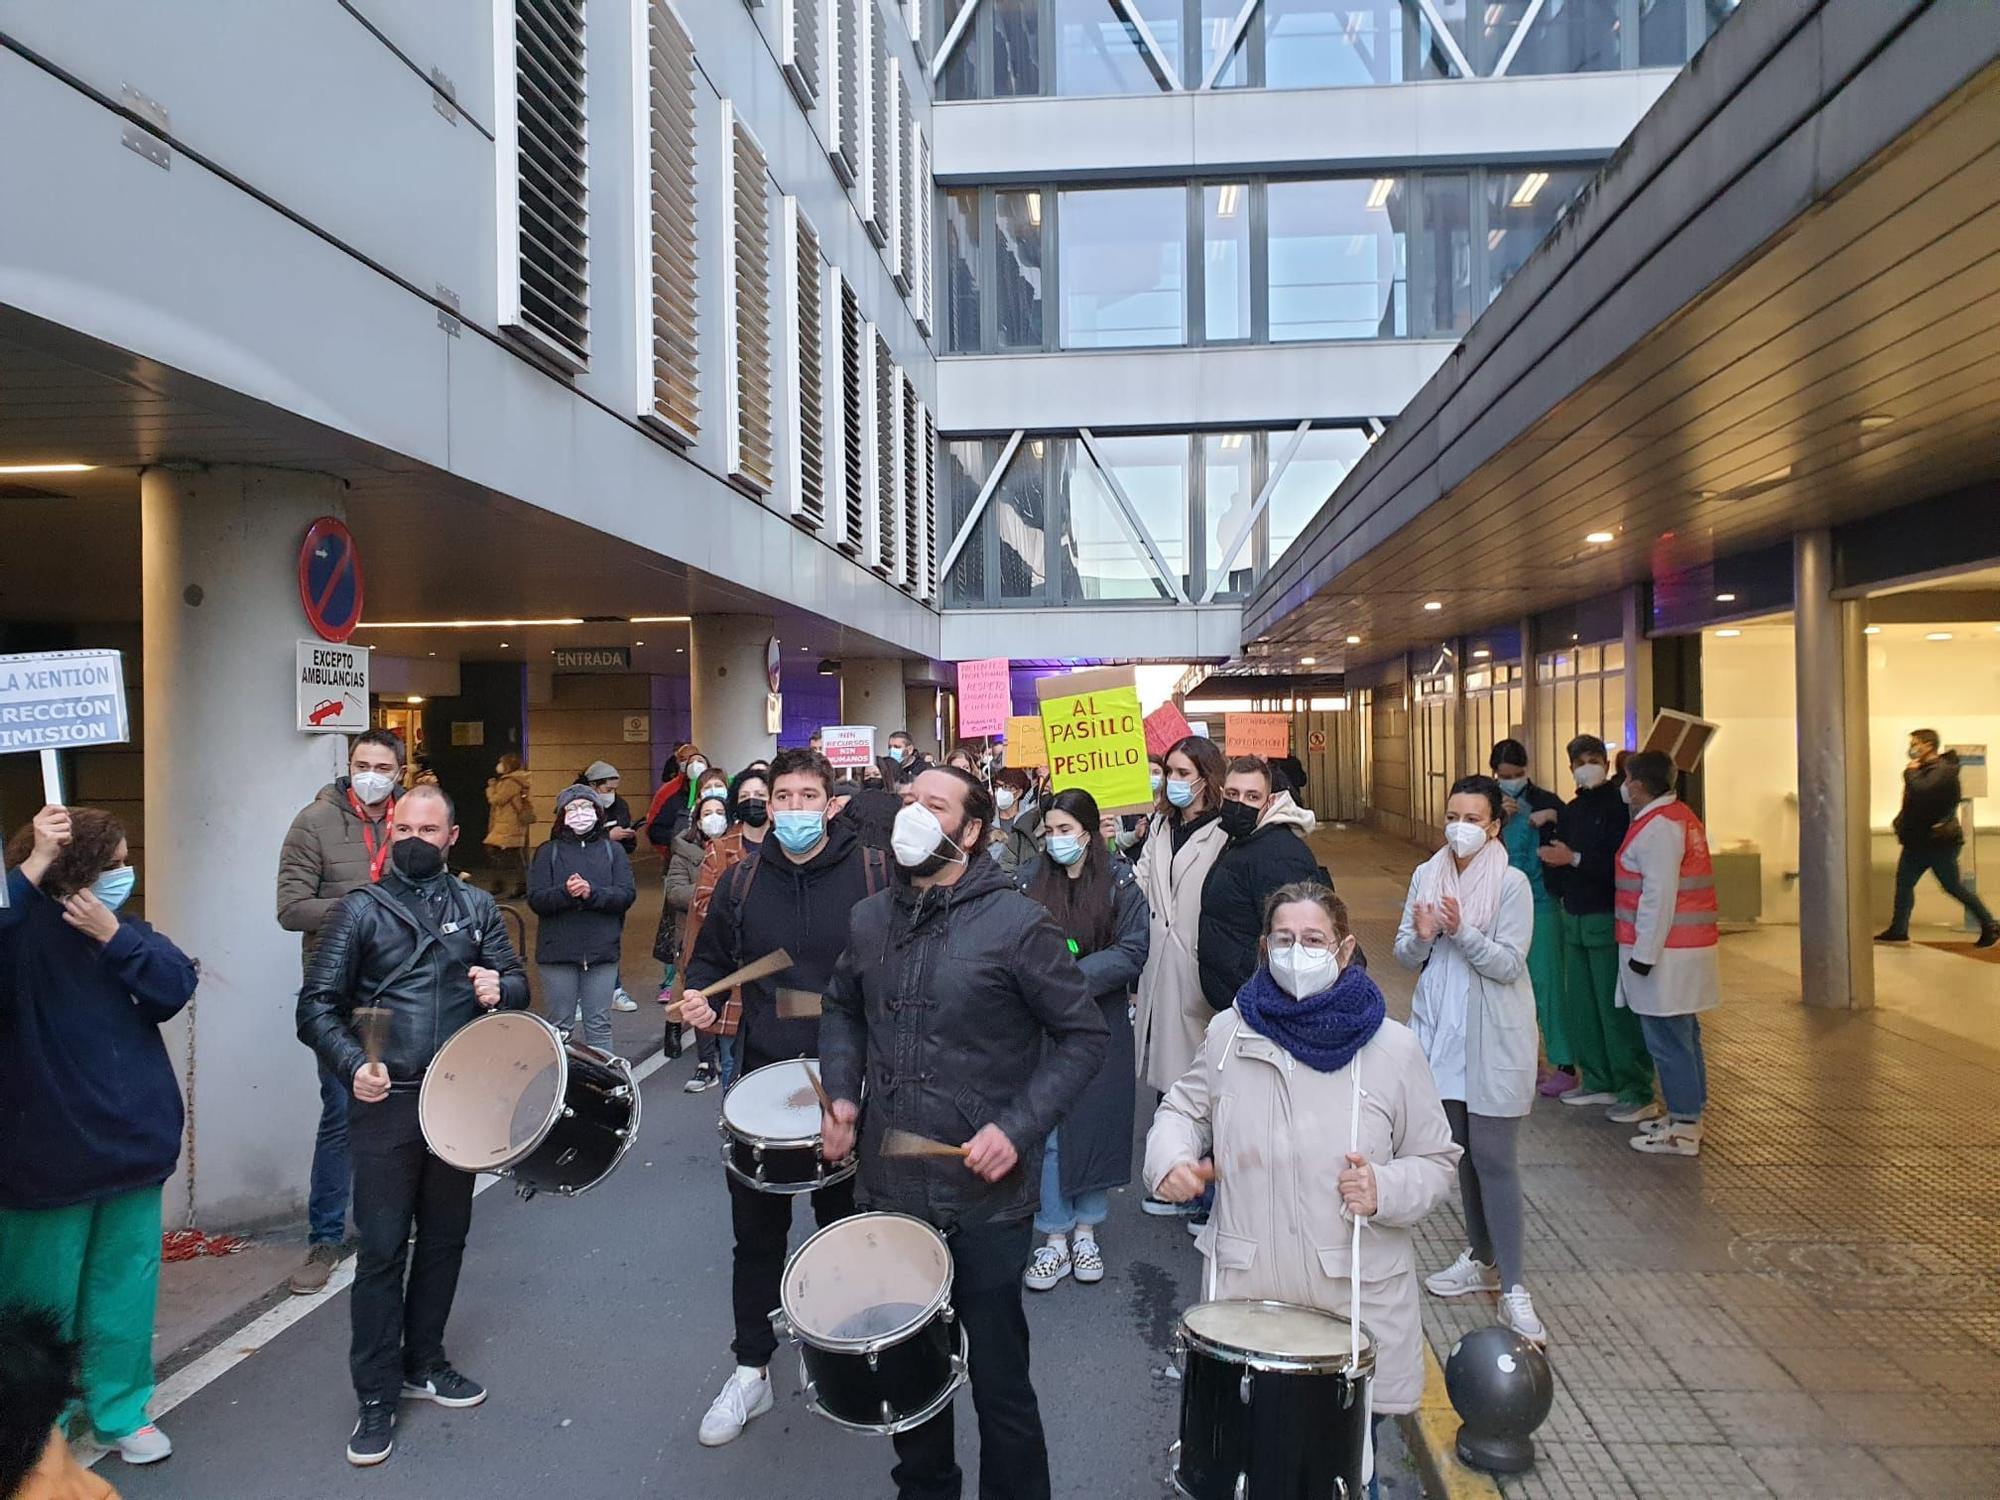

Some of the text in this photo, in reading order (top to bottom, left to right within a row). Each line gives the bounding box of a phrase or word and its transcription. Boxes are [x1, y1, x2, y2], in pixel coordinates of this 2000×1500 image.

[313, 650, 353, 669] EXCEPTO
[557, 652, 622, 666] ENTRADA
[24, 661, 110, 690] XENTIÓN
[302, 667, 365, 687] AMBULANCIAS
[0, 696, 111, 723] RECCIÓN
[1073, 696, 1101, 717] AL
[826, 739, 870, 747] RECURSOS
